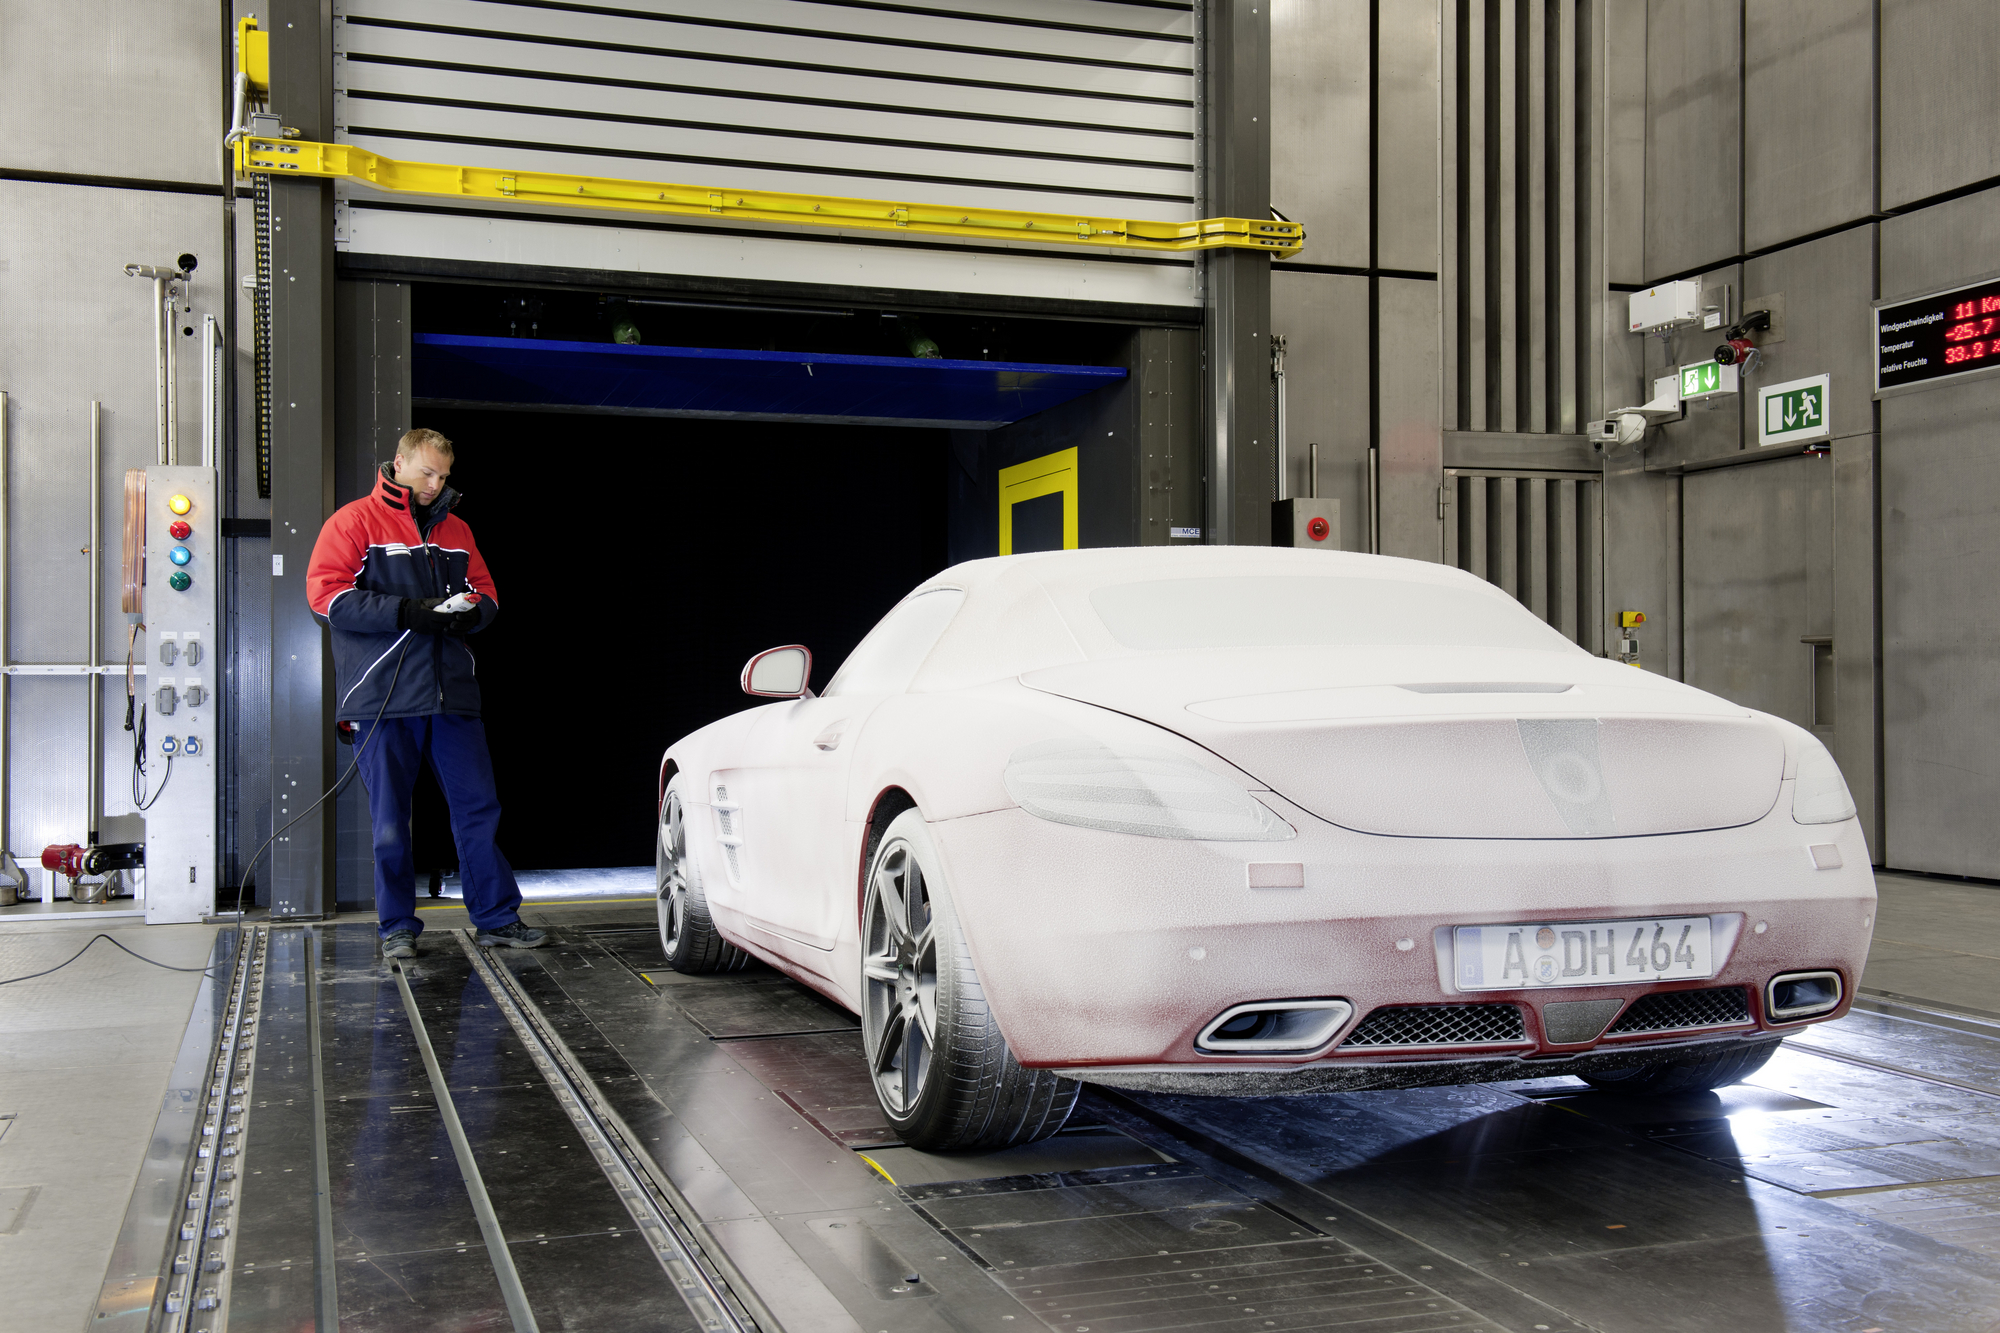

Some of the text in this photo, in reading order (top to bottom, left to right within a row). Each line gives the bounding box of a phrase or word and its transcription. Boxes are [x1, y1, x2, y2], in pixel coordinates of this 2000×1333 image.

[1881, 312, 1944, 332] Windgeschwindigkeit
[1956, 301, 1974, 319] 11
[1881, 340, 1914, 354] Temperatur
[1881, 362, 1902, 374] relative
[1903, 357, 1928, 370] Feuchte
[1465, 925, 1695, 979] D A DH 464
